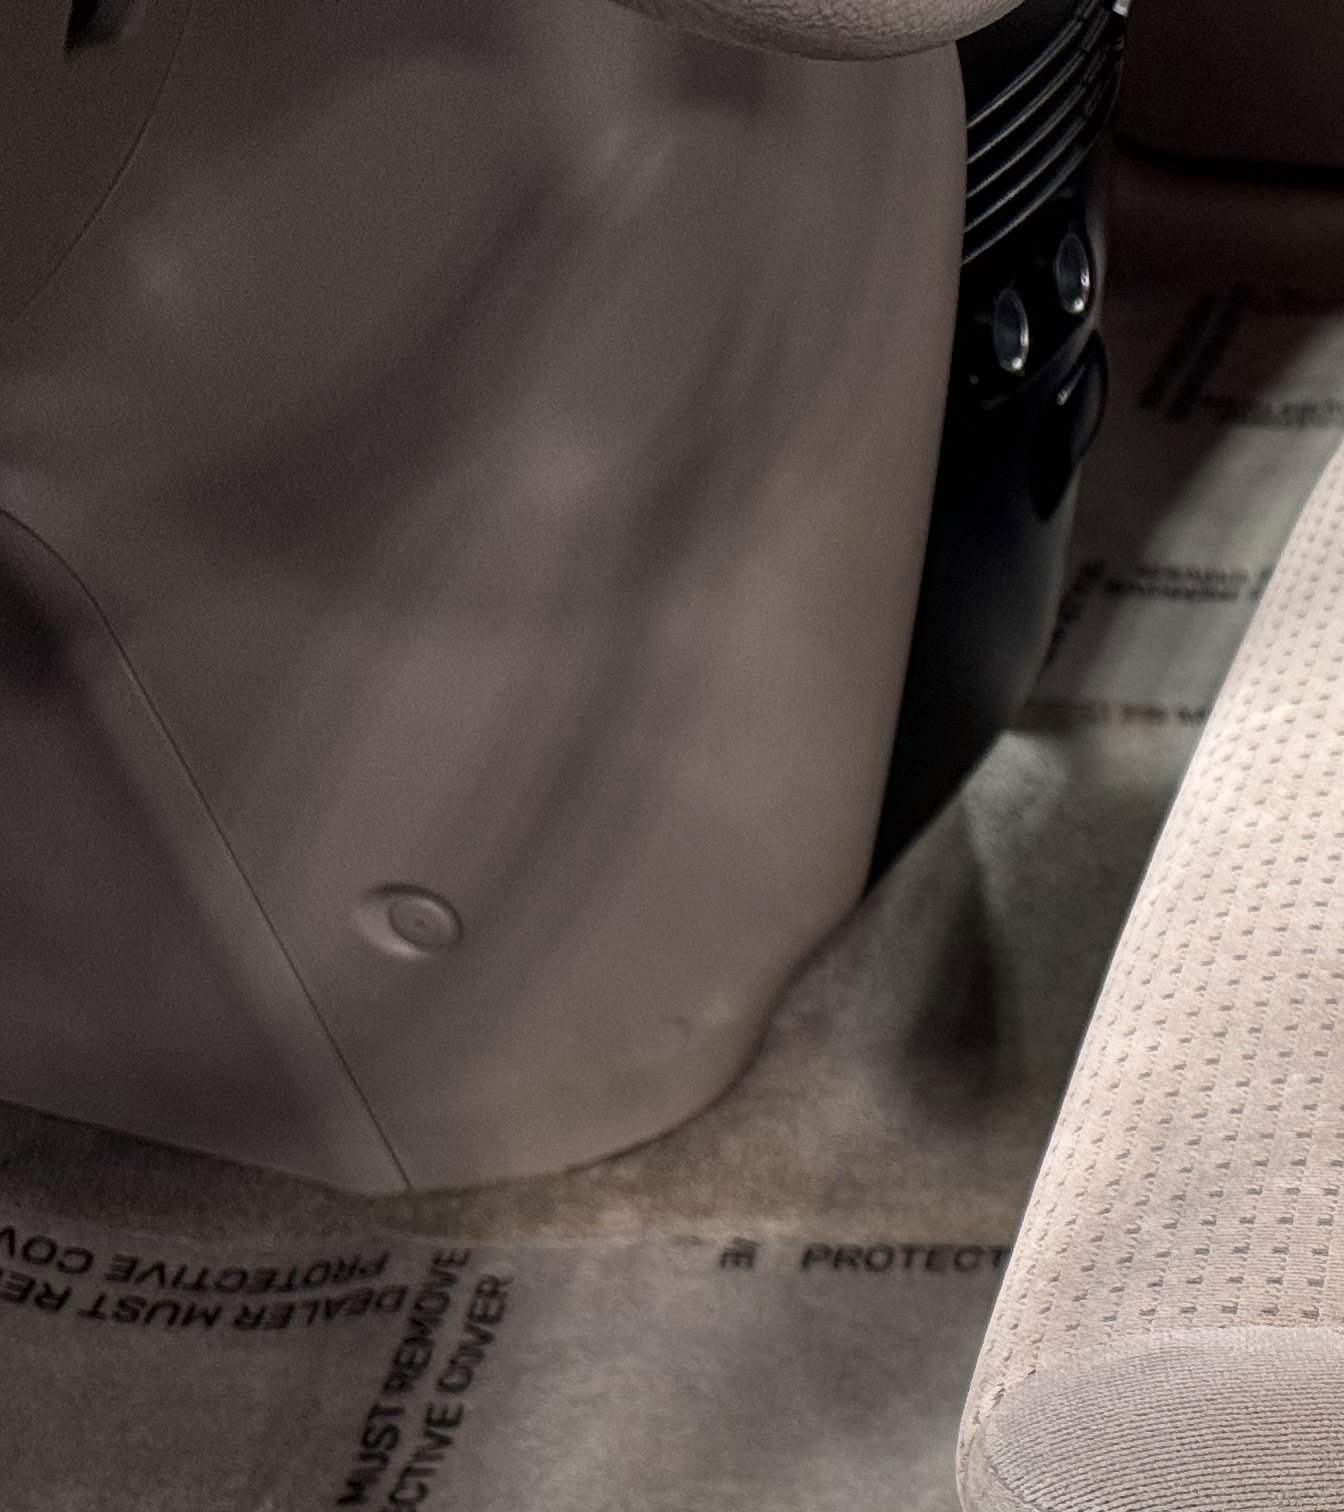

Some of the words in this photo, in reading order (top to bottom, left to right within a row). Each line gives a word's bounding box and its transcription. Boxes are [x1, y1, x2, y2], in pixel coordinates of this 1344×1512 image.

[104, 1252, 390, 1295] PROTECTIVE
[78, 1292, 222, 1329] MUST
[232, 1284, 408, 1331] DEALER
[437, 1274, 514, 1394] COVER
[337, 1403, 406, 1504] MUST
[382, 1248, 471, 1394] REMOVE
